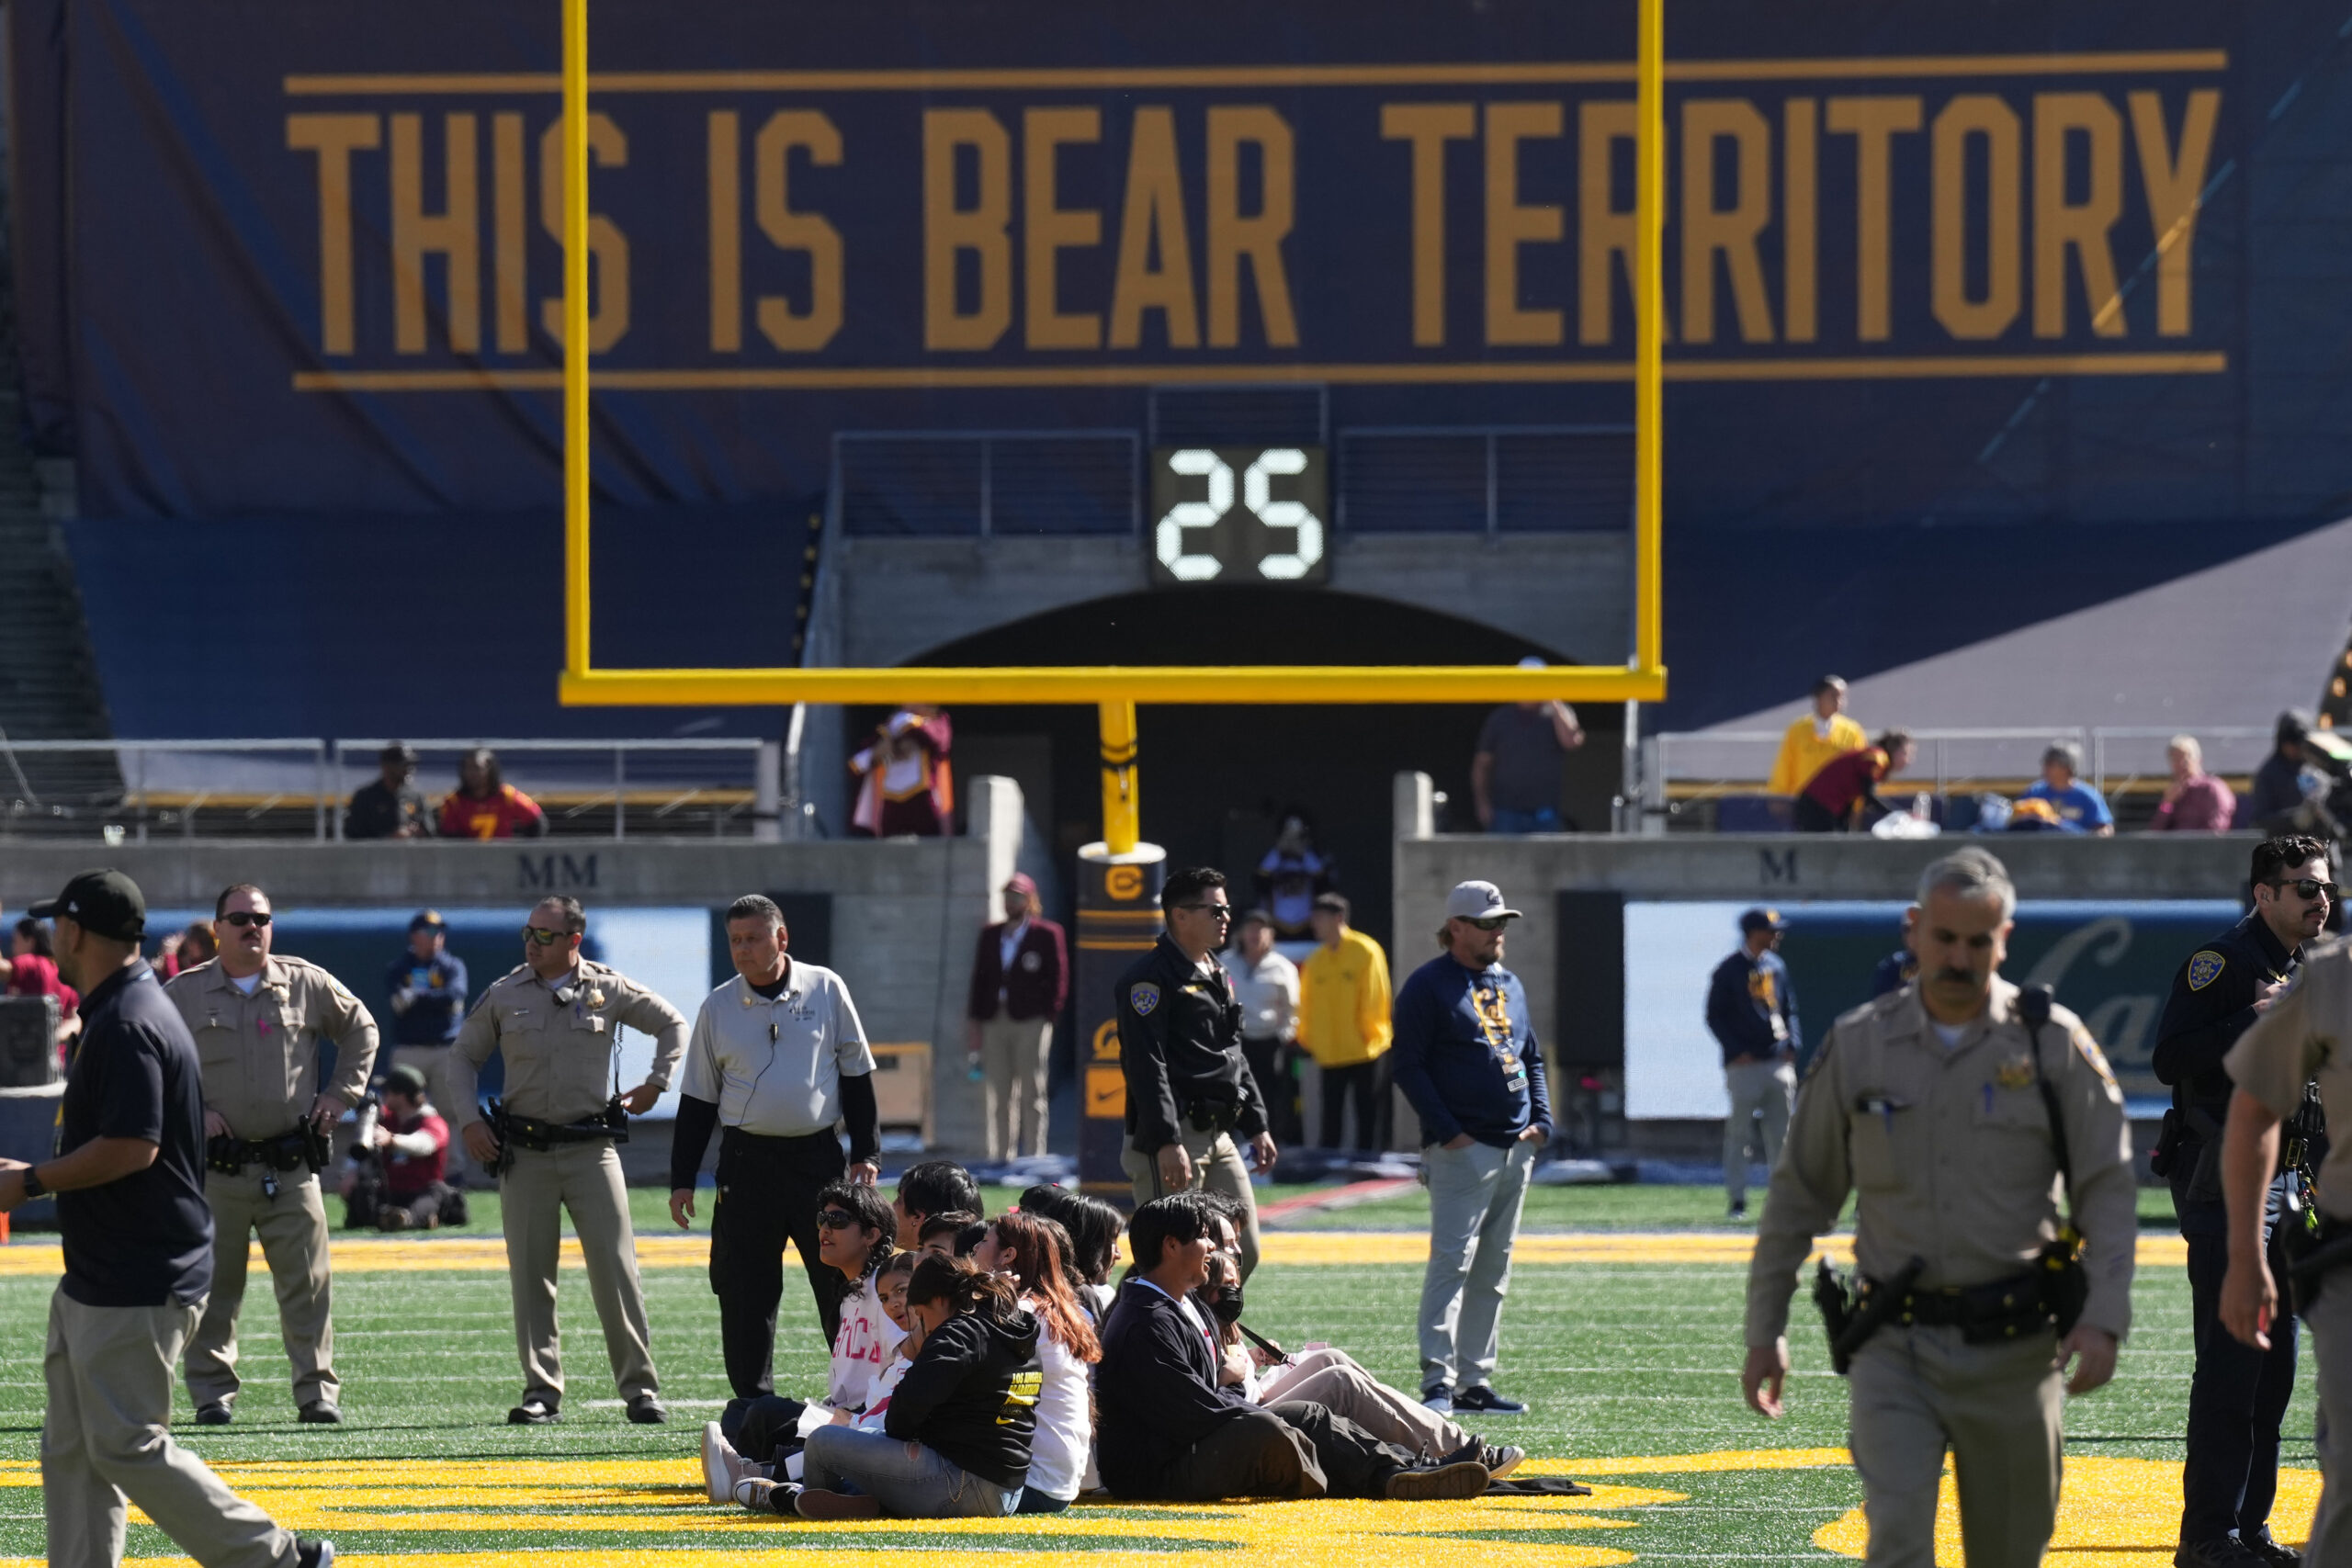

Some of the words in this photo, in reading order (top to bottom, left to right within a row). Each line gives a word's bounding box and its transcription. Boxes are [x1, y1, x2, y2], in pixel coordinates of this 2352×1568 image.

[286, 111, 630, 355] THIS
[707, 109, 844, 353] IS
[922, 105, 1302, 351] BEAR
[1380, 89, 2222, 348] TERRITORY
[1156, 448, 1324, 581] 25
[517, 853, 599, 888] MM
[1759, 847, 1799, 884] M
